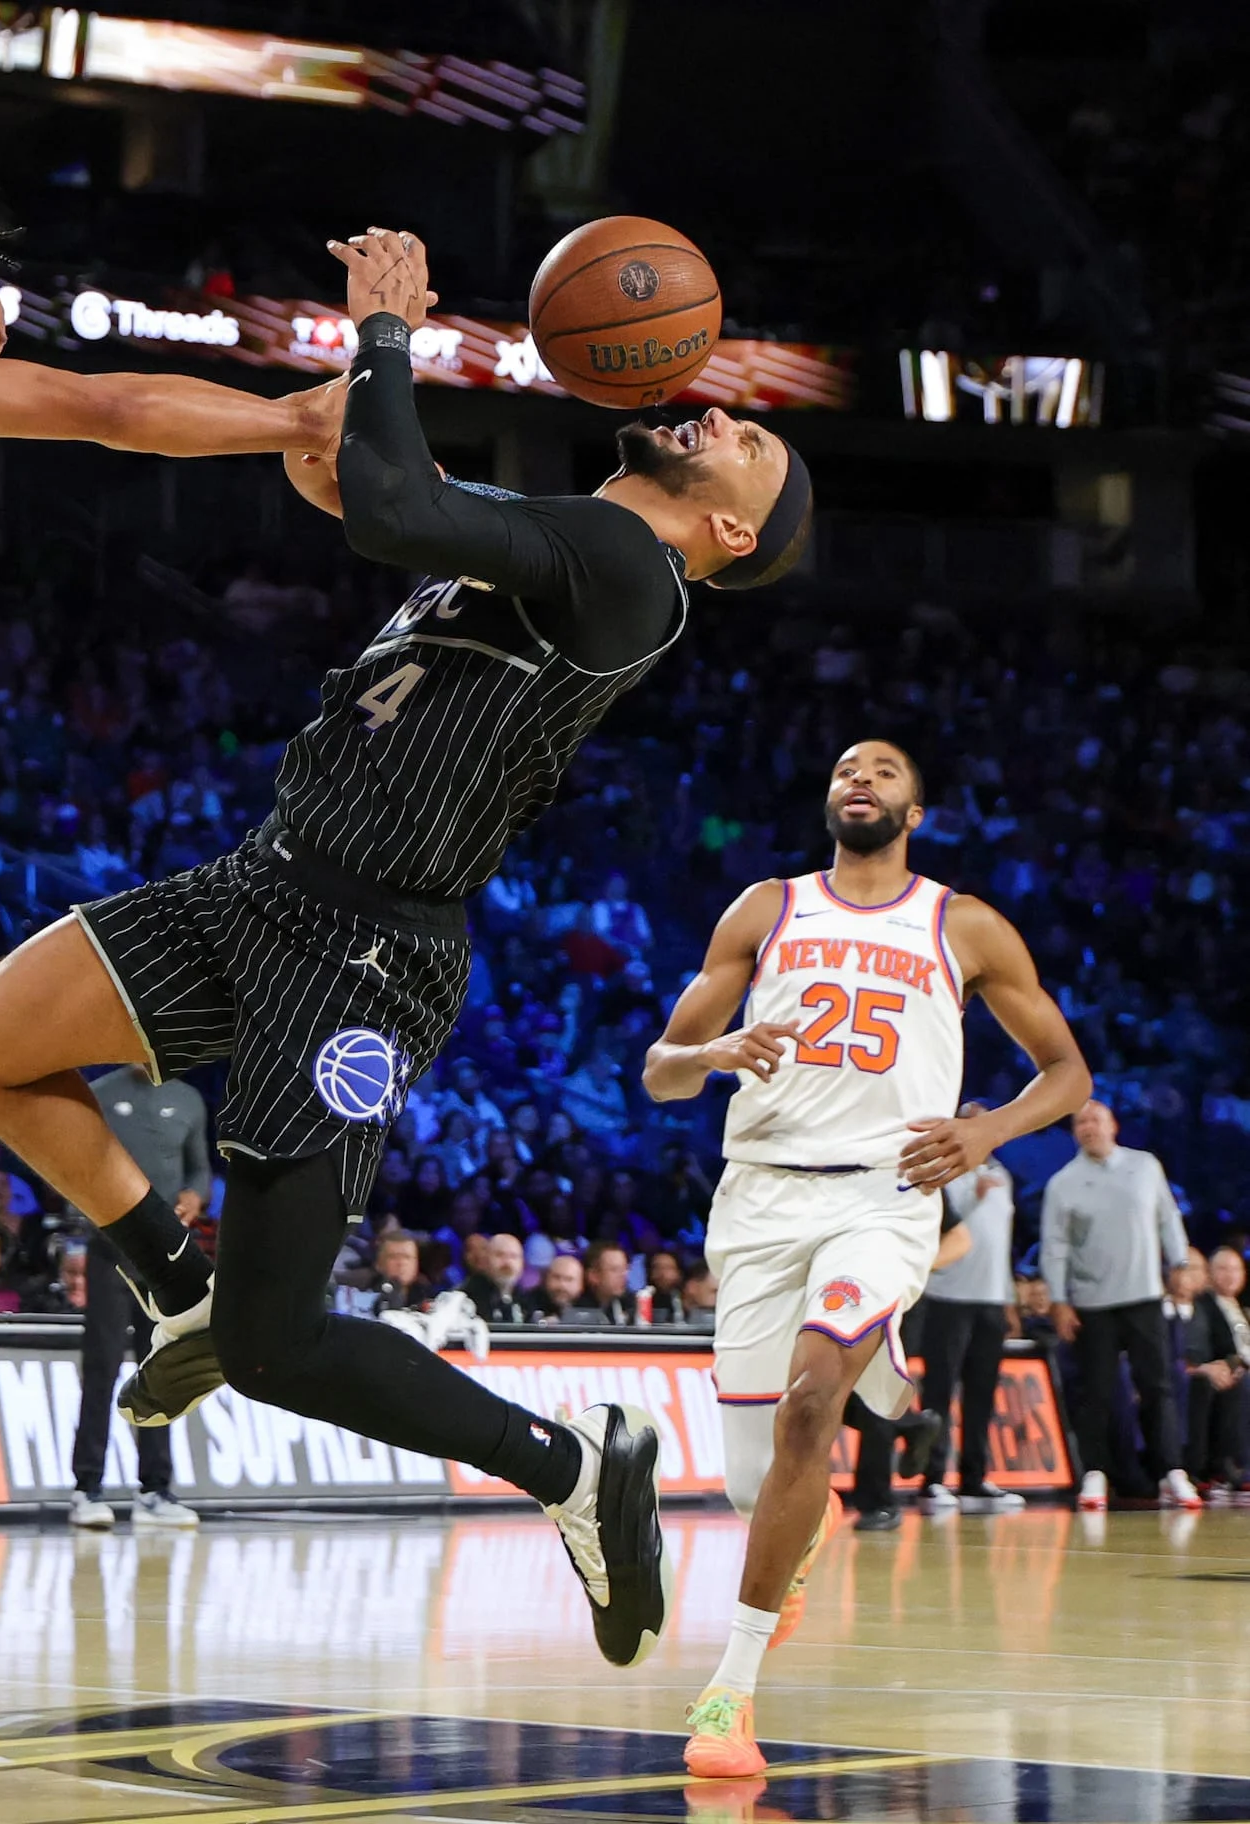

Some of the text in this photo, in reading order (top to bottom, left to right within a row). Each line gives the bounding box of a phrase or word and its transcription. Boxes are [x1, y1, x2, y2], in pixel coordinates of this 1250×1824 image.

[112, 299, 240, 347] Threads
[586, 328, 708, 372] Wilson
[354, 662, 427, 732] 4
[778, 938, 938, 996] NEW YORK
[795, 981, 906, 1075] 25
